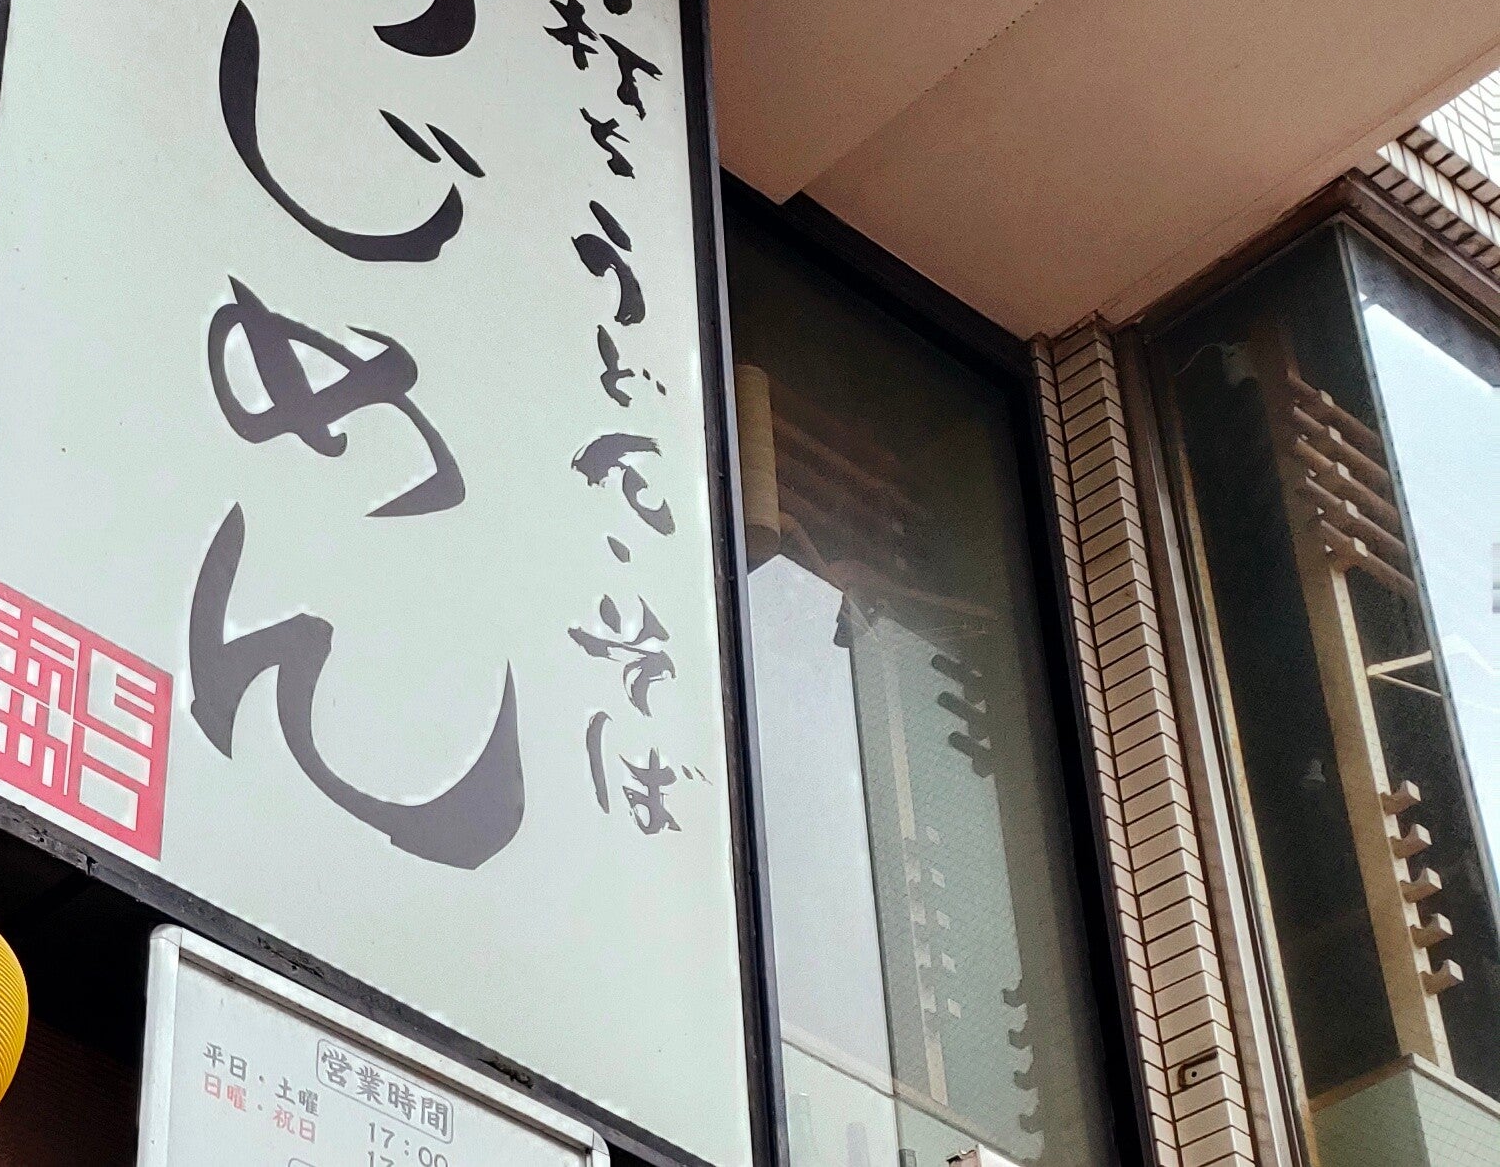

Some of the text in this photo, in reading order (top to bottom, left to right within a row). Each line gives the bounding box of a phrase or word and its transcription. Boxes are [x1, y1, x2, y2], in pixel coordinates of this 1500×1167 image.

[203, 1042, 318, 1117] 平日・土曜
[204, 1073, 316, 1143] 日曜・祝日
[321, 1047, 449, 1137] 営業時間
